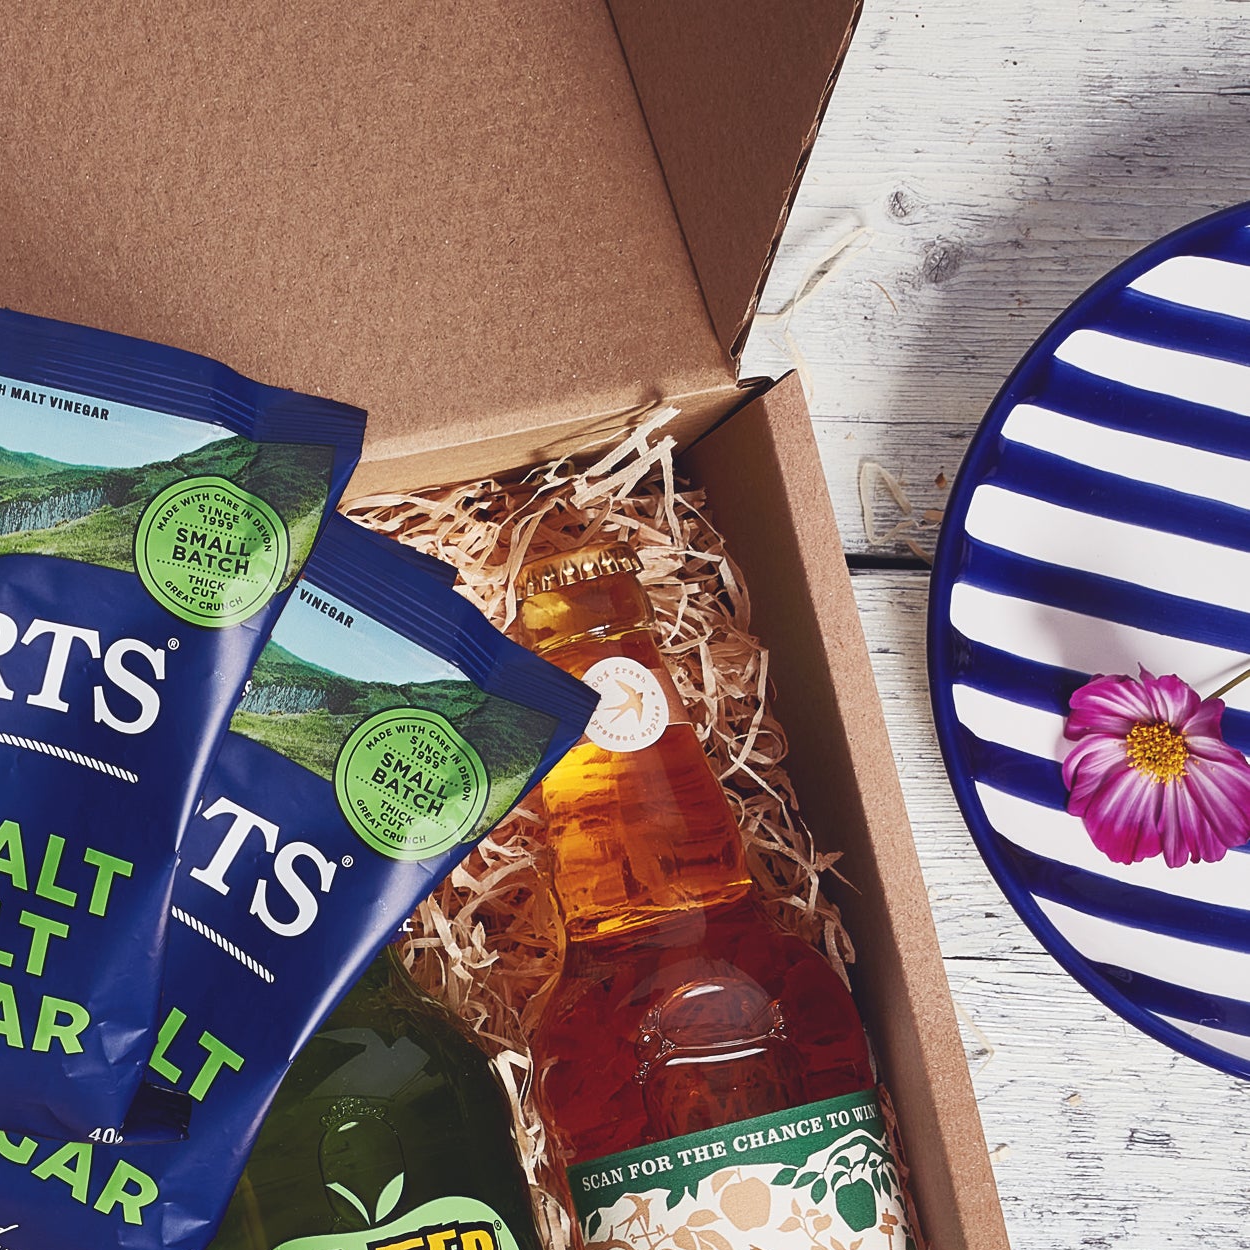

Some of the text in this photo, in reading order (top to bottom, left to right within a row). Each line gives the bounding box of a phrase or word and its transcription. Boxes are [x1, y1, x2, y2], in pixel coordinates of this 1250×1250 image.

[10, 386, 47, 407] MALT
[49, 396, 110, 421] VINEGAR
[157, 492, 272, 552] MADE WITH CARE IN DEVON
[198, 504, 240, 523] SINCE
[202, 515, 233, 530] 1999
[175, 527, 251, 557] SMALL
[172, 545, 249, 576] BATCH
[165, 580, 243, 611] GREAT CRUNCH
[188, 574, 226, 591] THICK
[191, 586, 218, 600] CUT
[299, 588, 354, 628] VINEGAR
[592, 670, 610, 688] 00%
[365, 725, 472, 802] MADE WITH CARE IN DEVON
[410, 735, 448, 765] SINCE
[411, 746, 440, 770] 1999
[371, 766, 444, 817] BATCH
[380, 752, 448, 800] SMALL
[356, 799, 426, 844] GREAT CRUNCH
[380, 813, 404, 831] CUT
[381, 800, 415, 825] THICK
[150, 1006, 244, 1102] LT
[582, 1167, 623, 1192] SCAN
[629, 1155, 673, 1180] FOR
[677, 1141, 727, 1167] THE
[732, 1116, 824, 1155] CHANCE
[826, 1110, 850, 1129] TO
